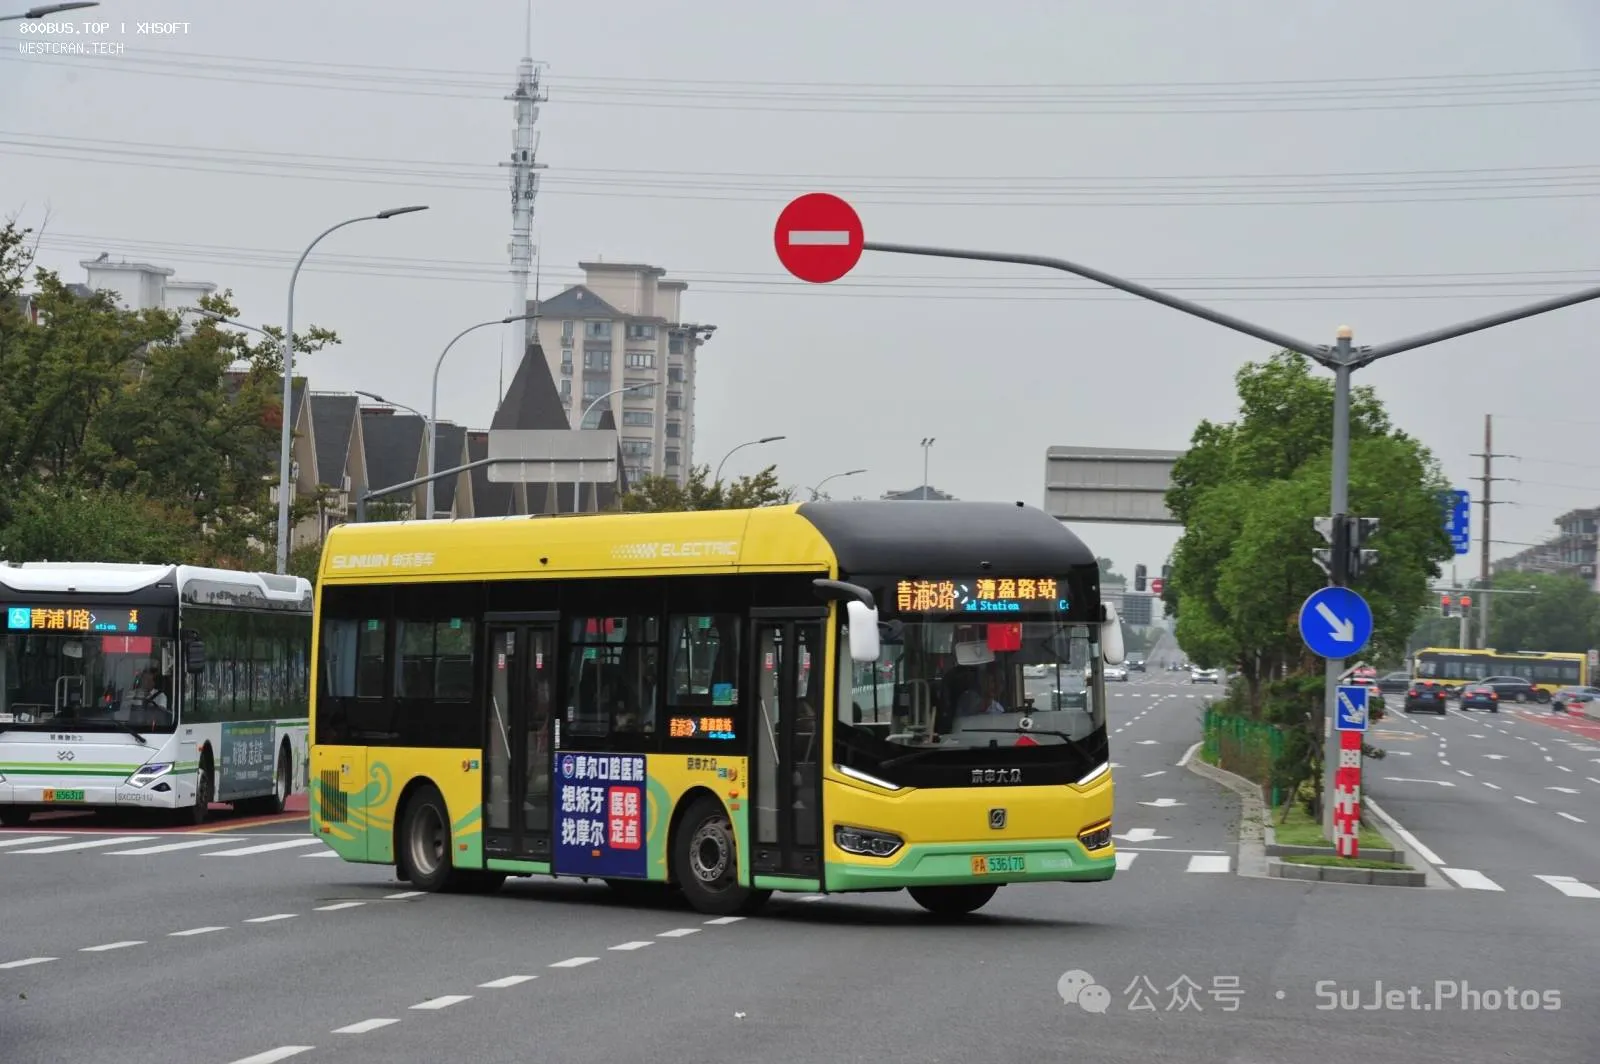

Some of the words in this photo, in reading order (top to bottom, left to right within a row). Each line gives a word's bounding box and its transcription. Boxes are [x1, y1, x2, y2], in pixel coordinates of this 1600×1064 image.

[661, 541, 738, 556] ELECTRIC
[331, 555, 389, 569] SUNWIN
[897, 580, 955, 611] 青浦5路
[976, 579, 1057, 599] 漕盈路站
[980, 600, 1020, 610] Station
[31, 609, 90, 629] 青浦1路
[575, 755, 644, 781] 摩尔口腔医院
[562, 785, 604, 813] 想矫牙
[611, 792, 638, 816] 医保
[562, 819, 604, 846] 找摩尔
[611, 819, 638, 844] 定点
